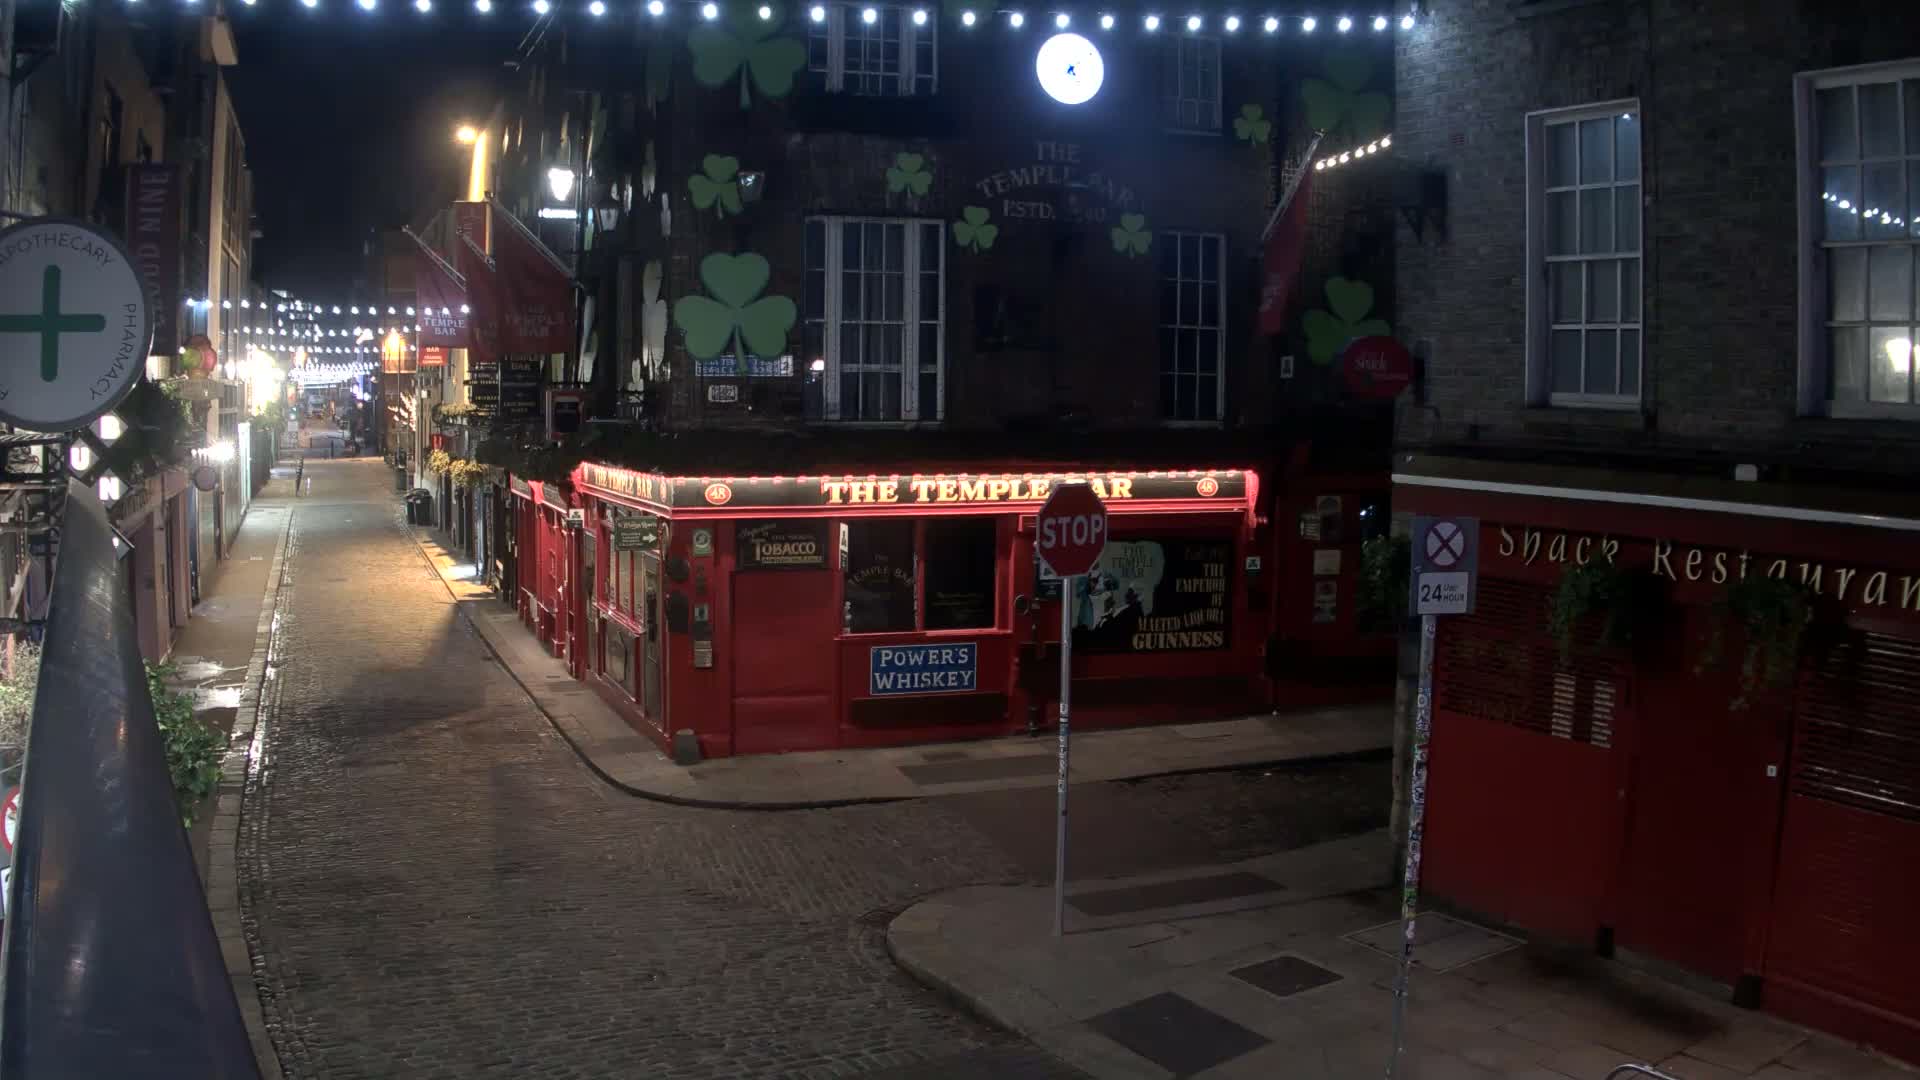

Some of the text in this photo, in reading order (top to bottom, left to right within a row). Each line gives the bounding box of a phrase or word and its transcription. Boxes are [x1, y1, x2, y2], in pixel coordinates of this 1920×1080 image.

[1037, 142, 1081, 162] THE
[424, 317, 465, 328] TEMPLE
[434, 327, 457, 337] BAR
[90, 303, 137, 401] PHARMACY
[822, 478, 1133, 503] THE TEMPLE AR
[1041, 513, 1104, 549] STOP
[751, 539, 817, 561] TOBACCO
[1421, 584, 1442, 602] 24
[1132, 632, 1225, 650] GUINNESS
[880, 647, 969, 668] POWER'S
[874, 669, 974, 689] WHISKEY
